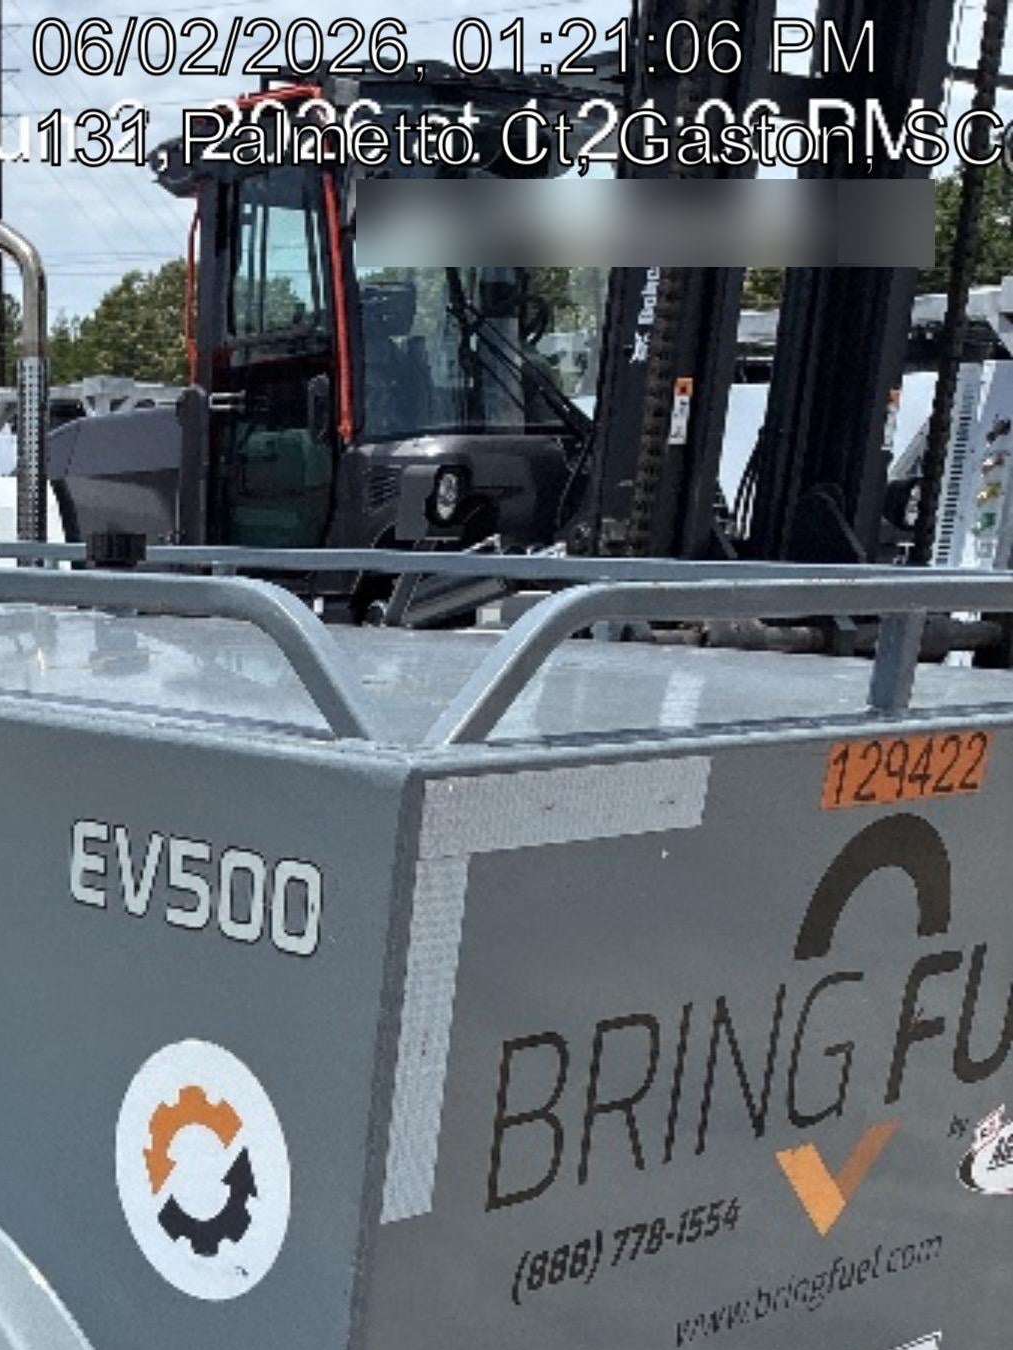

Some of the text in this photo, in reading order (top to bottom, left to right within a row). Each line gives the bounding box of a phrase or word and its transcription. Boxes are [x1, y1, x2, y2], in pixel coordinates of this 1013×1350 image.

[833, 731, 987, 804] 129422
[71, 818, 322, 957] EV500
[485, 971, 864, 1212] BRING
[511, 1197, 742, 1305] (888) 778-1554
[676, 1235, 943, 1347] www.bringfuel.com
